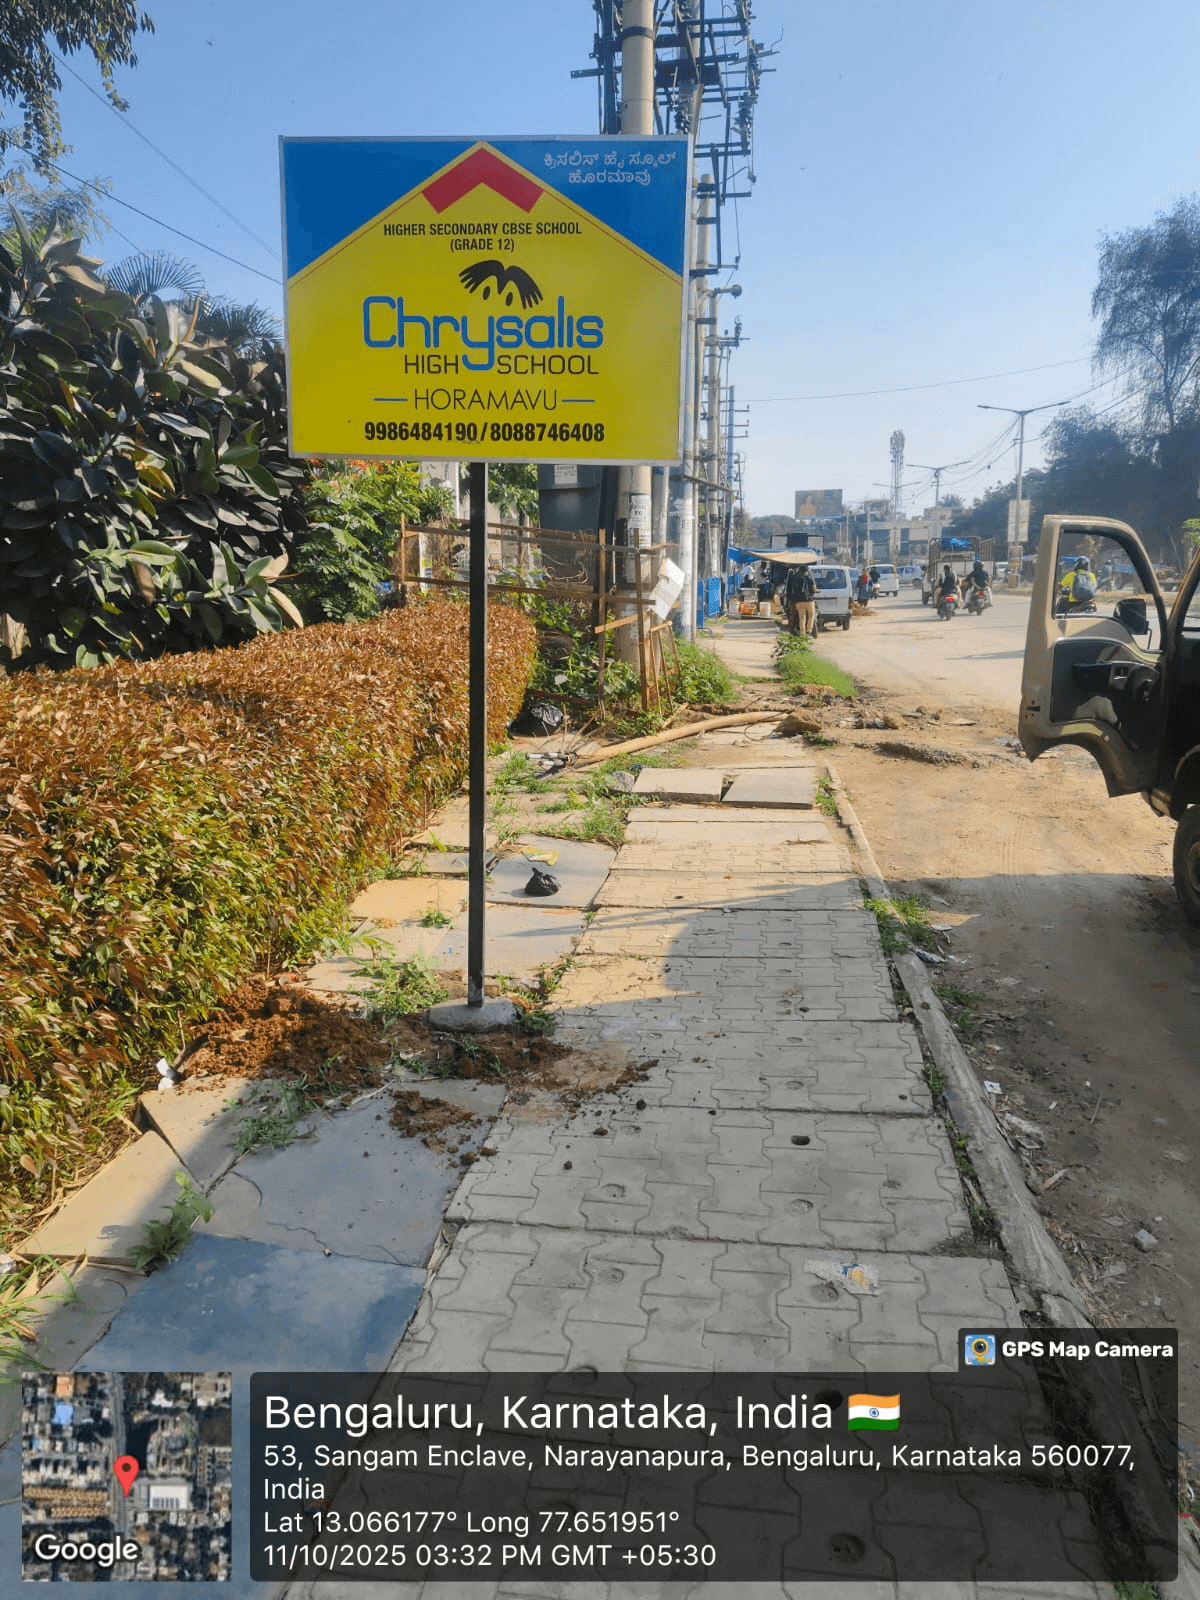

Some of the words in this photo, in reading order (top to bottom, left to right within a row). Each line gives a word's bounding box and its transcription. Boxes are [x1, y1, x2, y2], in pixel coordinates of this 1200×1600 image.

[383, 223, 426, 236] HIGHER
[429, 223, 498, 236] SECONDARY
[502, 222, 532, 235] CBSE
[536, 222, 582, 235] SCHOOL
[450, 238, 493, 252] (GRADE
[498, 238, 515, 252] 12)
[363, 296, 604, 371] Chrysalis
[404, 354, 459, 375] HIGH
[497, 354, 600, 375] SCHOOL
[414, 388, 558, 411] HORAMAVU
[364, 421, 605, 442] 9986484190/8088746408
